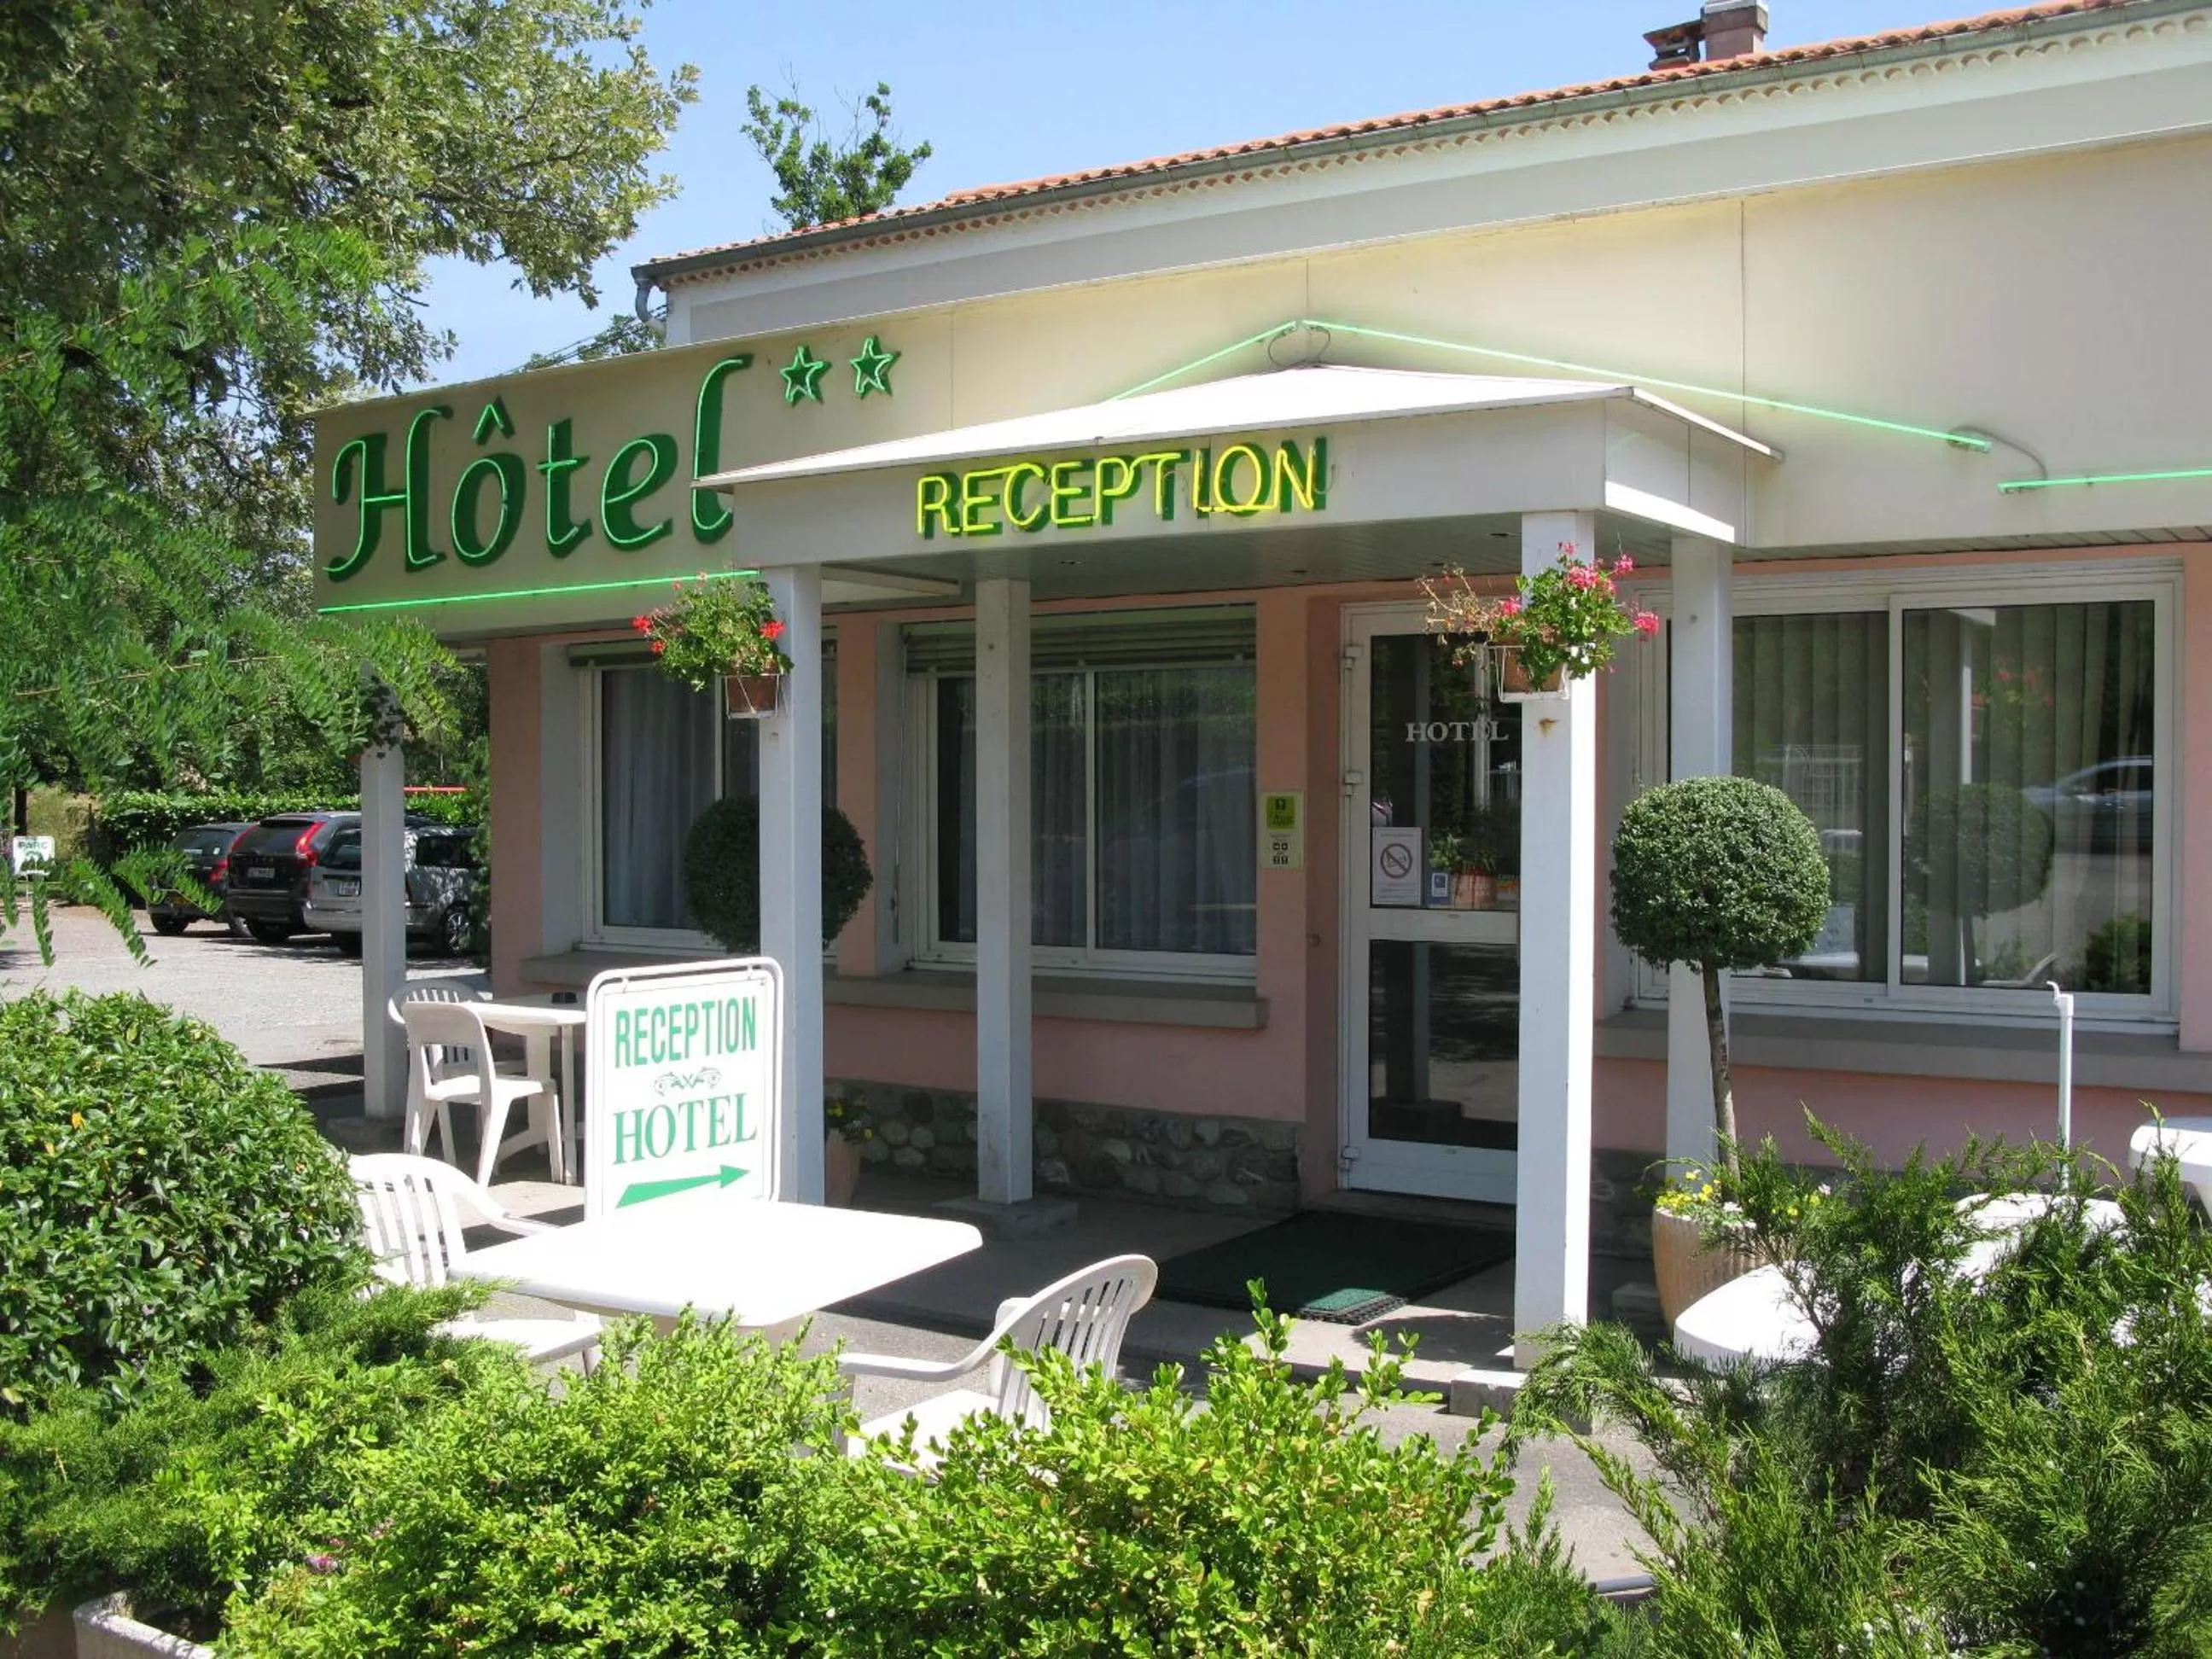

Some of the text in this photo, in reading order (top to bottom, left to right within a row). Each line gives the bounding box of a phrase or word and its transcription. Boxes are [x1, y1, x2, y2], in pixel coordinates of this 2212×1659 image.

[323, 352, 754, 583] Hôtel
[917, 436, 1327, 540] RECEPTION
[1405, 720, 1510, 742] HOTEL
[614, 995, 756, 1069] RECEPTION
[611, 1092, 758, 1166] HOTEL
